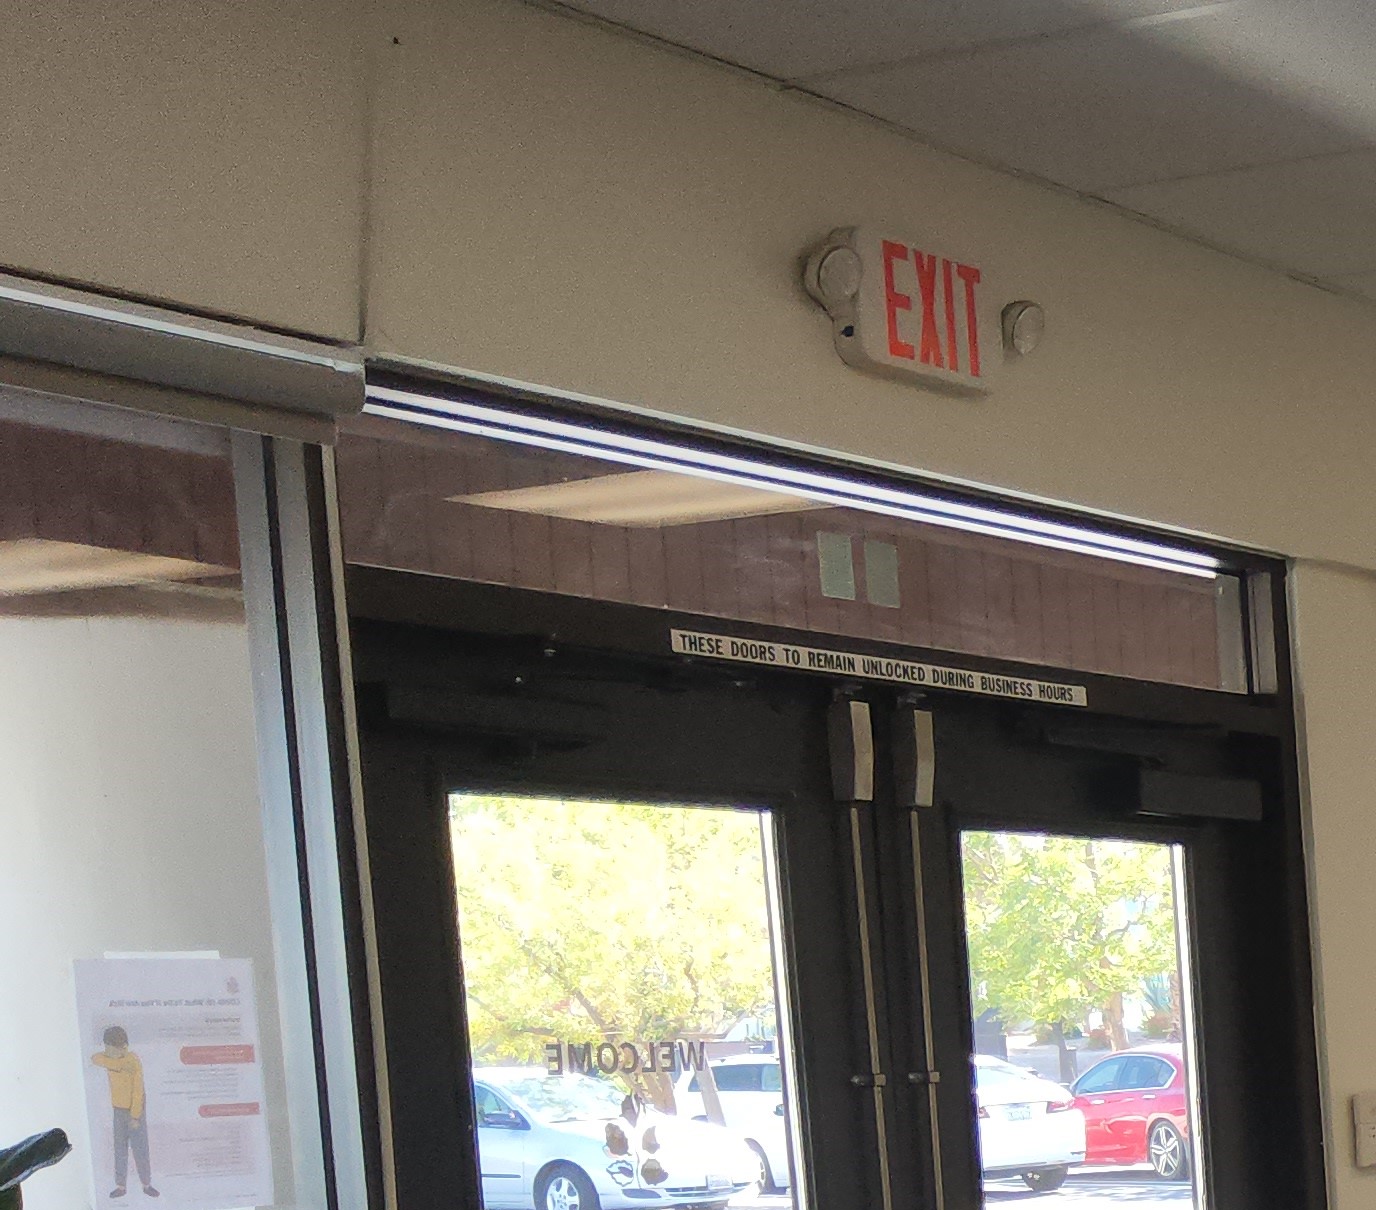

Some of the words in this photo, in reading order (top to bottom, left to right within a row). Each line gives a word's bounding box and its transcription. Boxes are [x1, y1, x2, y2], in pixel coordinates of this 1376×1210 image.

[882, 239, 981, 378] EXIT
[680, 633, 724, 656] THESE
[731, 640, 776, 662] DOORS
[783, 648, 801, 666] TO
[808, 651, 856, 673] REMAIN
[862, 658, 926, 683] UNLOCKED
[931, 671, 975, 690] DURING
[980, 676, 1033, 698] BUSINESS
[1037, 683, 1074, 702] HOURS
